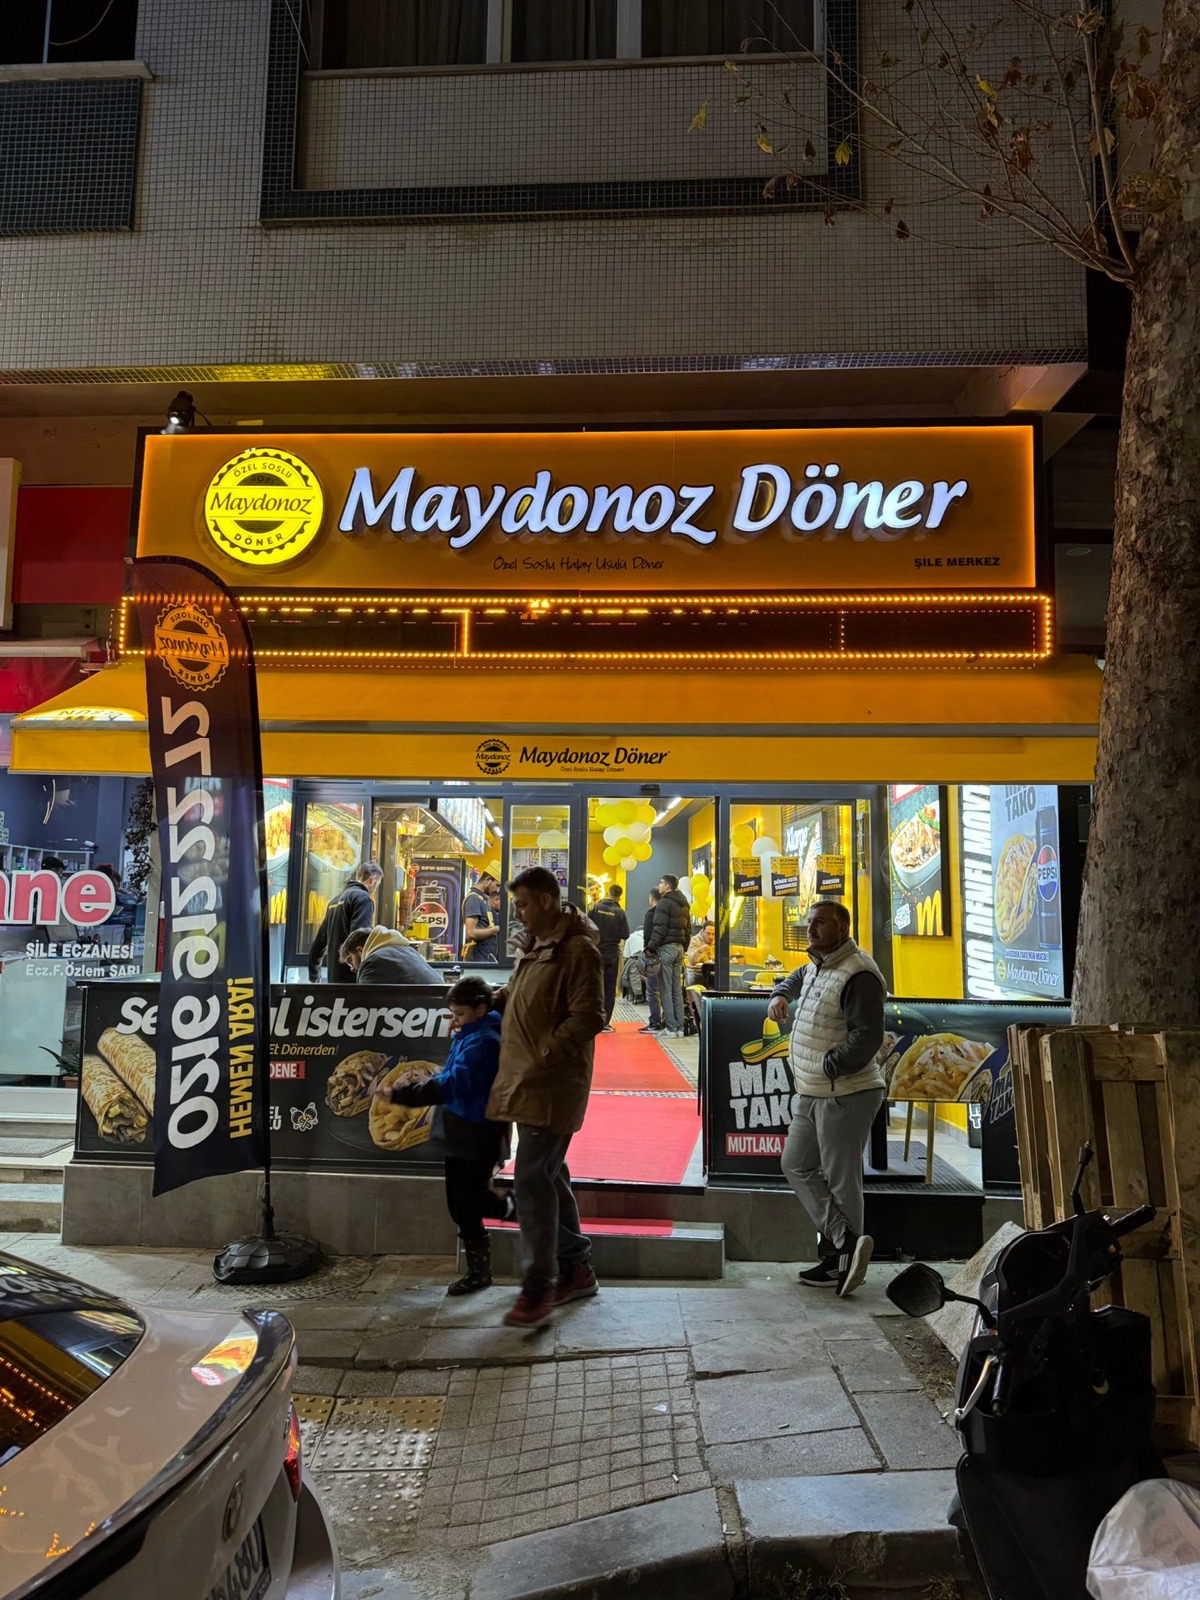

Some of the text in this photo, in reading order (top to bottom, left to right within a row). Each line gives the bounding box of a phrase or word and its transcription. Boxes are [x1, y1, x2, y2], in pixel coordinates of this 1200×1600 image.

[233, 462, 293, 479] ÖZEL SOSLU
[209, 491, 313, 516] Maydonoz
[337, 462, 969, 549] Maydonoz Döner
[233, 532, 284, 547] DÖNER
[493, 555, 518, 570] Özel
[522, 556, 555, 570] Soslu
[560, 556, 593, 573] Hatay
[631, 556, 665, 571] Döner
[914, 556, 1001, 570] ŞİLE MERKEZ
[519, 746, 668, 768] Maydonoz Döner
[1004, 785, 1037, 823] TAKO
[1038, 866, 1058, 880] PEPSI
[26, 940, 135, 959] ŞİLE ECZANESİ
[1006, 962, 1060, 986] Maydonoz Döner
[728, 1057, 791, 1098] MA
[727, 1136, 783, 1153] MUTLAKA
